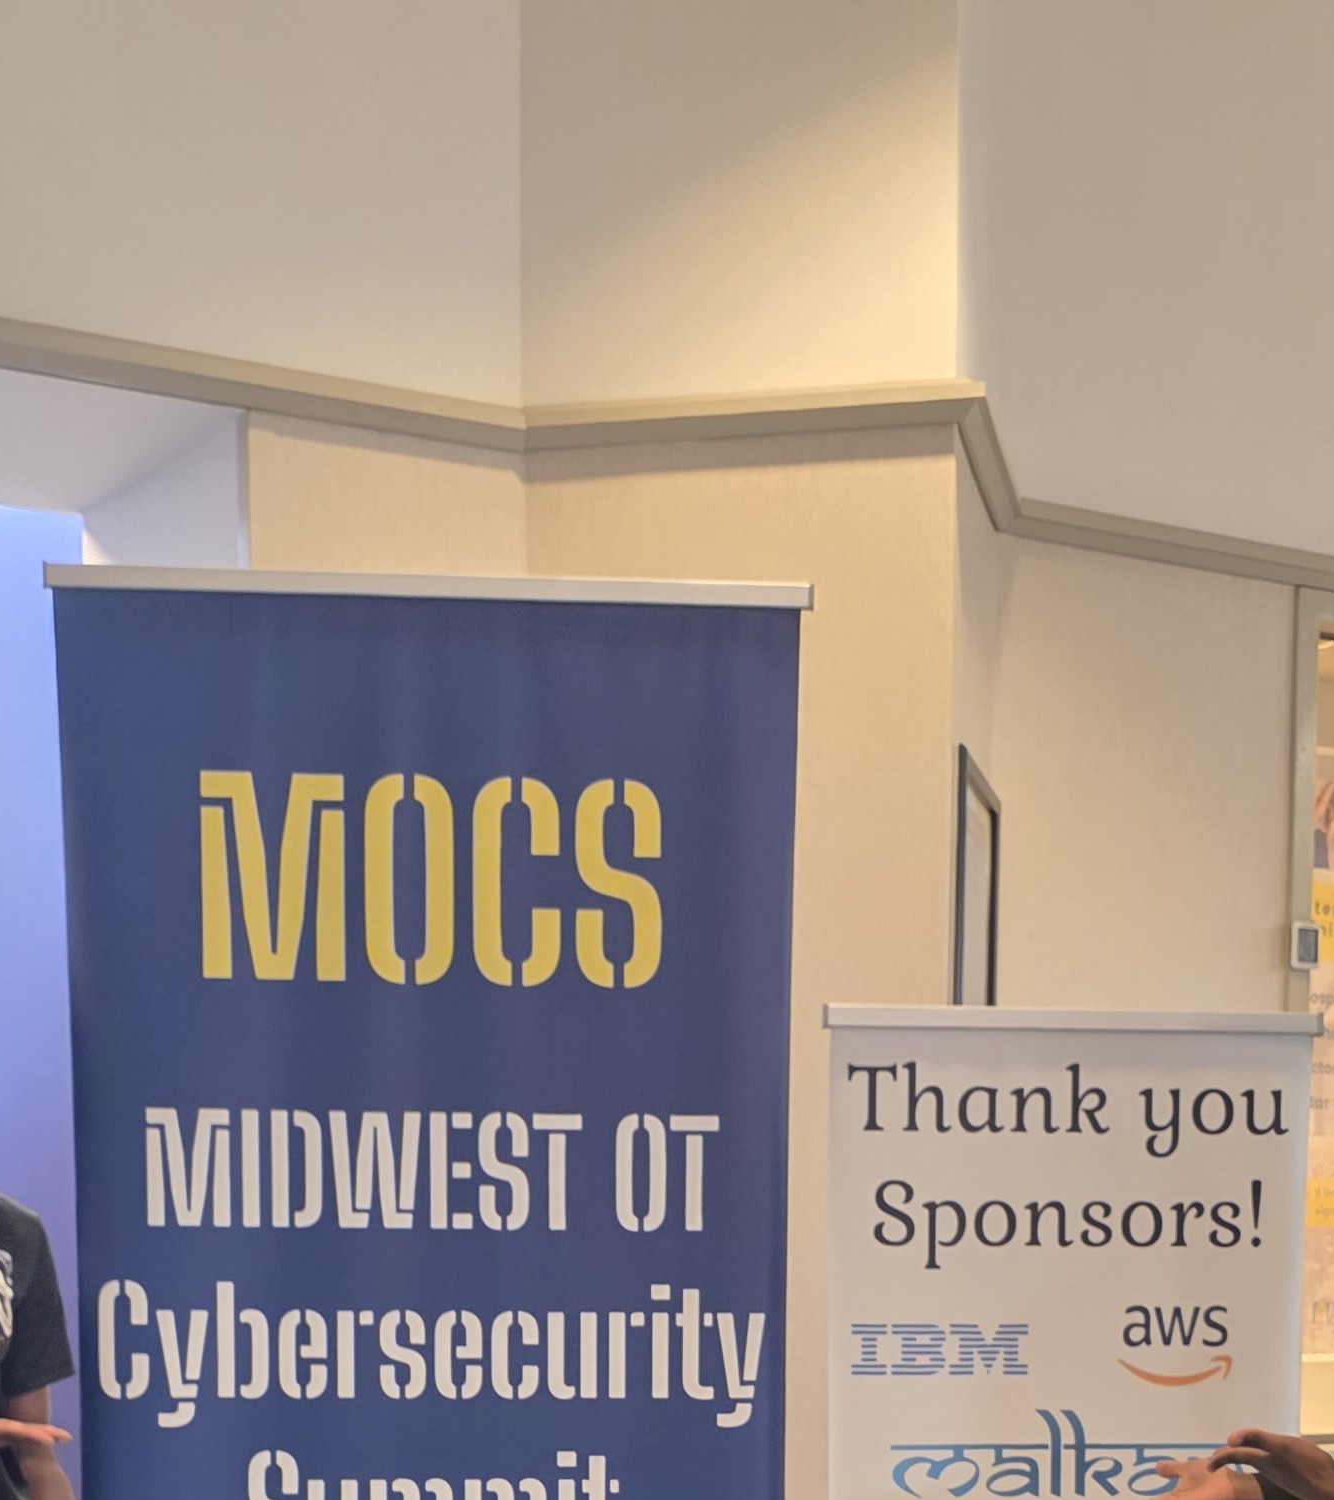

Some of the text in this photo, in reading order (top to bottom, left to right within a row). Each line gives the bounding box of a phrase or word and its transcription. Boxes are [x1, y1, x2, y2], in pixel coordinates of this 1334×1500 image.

[199, 769, 663, 989] MOCS
[847, 1060, 1290, 1159] Thank you
[145, 1106, 720, 1232] MIDWEST OT
[872, 1178, 1264, 1271] Sponsors!
[97, 1279, 767, 1429] Cybersecurity
[851, 1304, 1229, 1376] IBM aws
[889, 1408, 1245, 1499] malka
